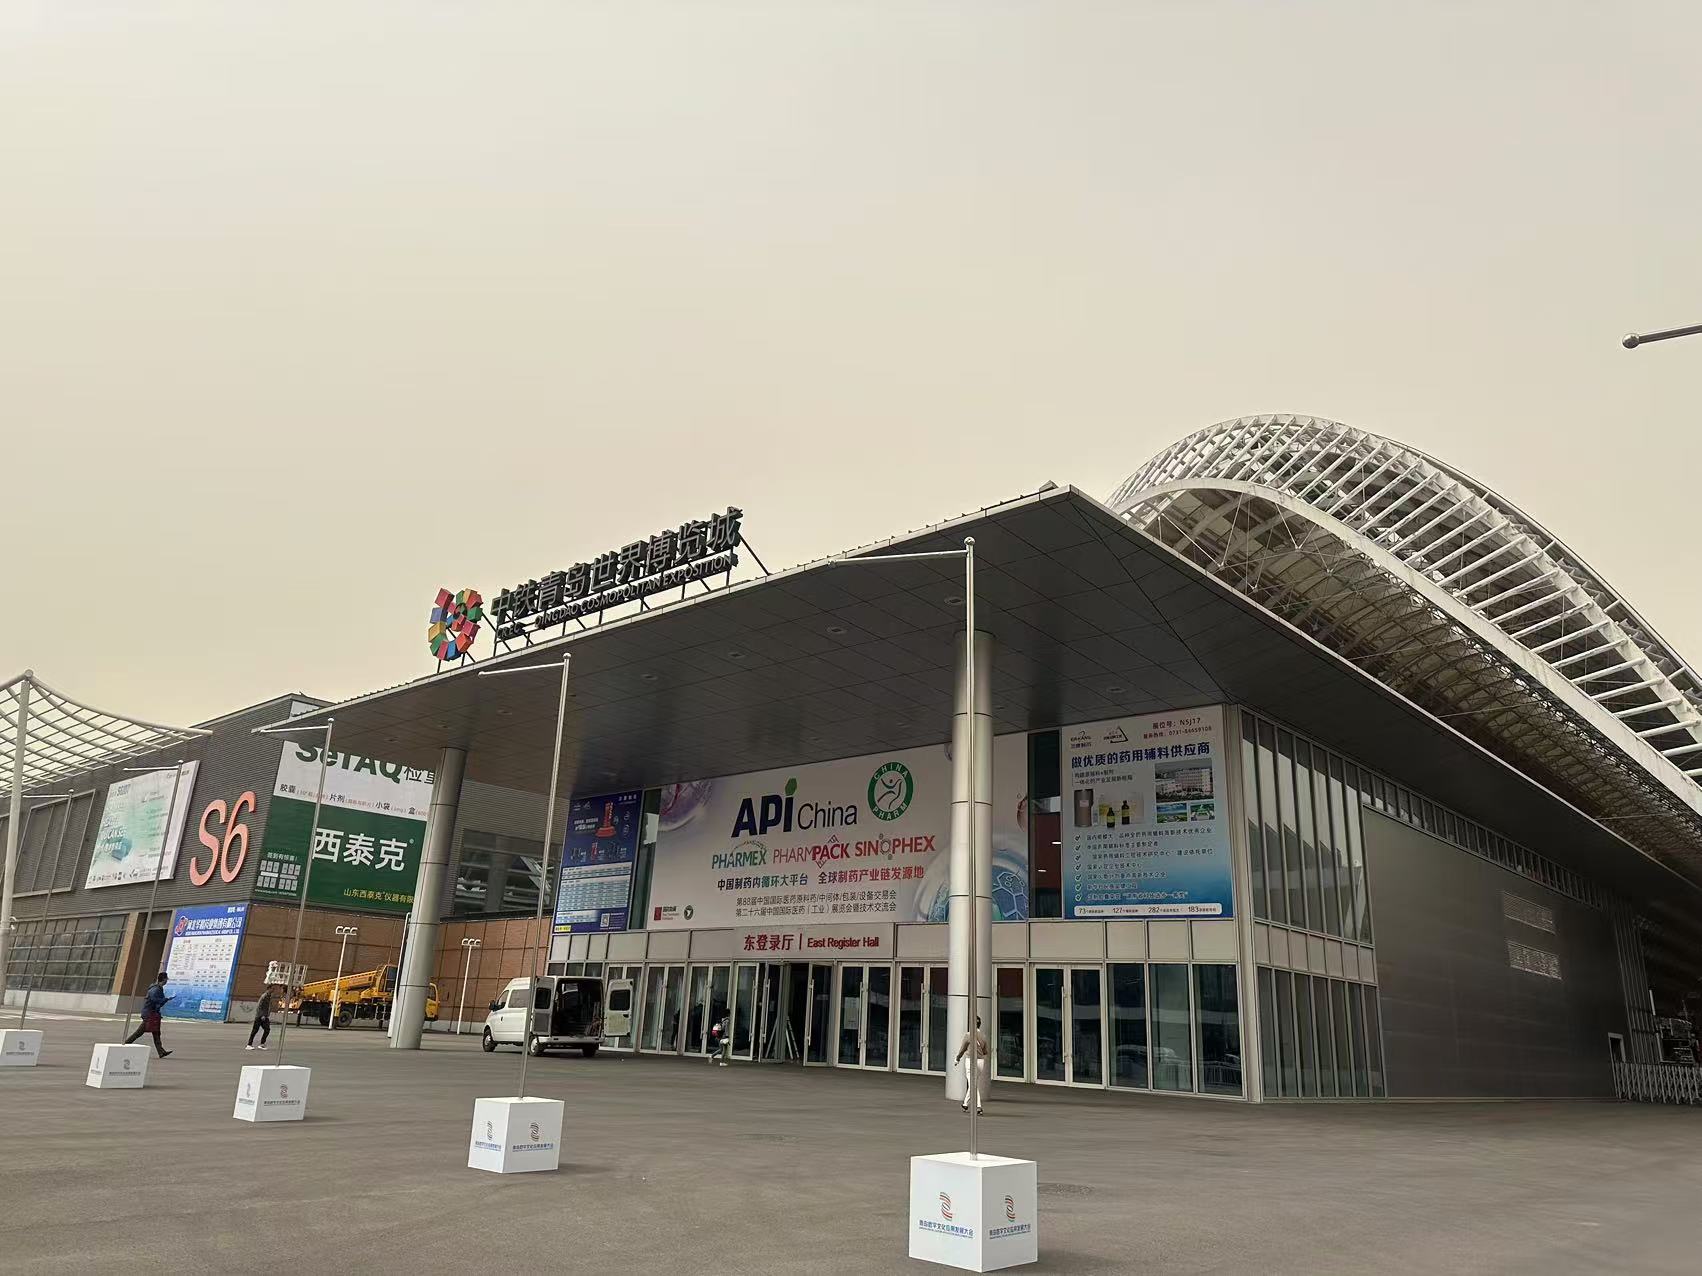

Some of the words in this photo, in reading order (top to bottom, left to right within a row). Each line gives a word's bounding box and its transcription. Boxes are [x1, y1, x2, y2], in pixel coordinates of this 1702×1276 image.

[490, 506, 743, 621] 中铁青岛世界博览城
[534, 603, 580, 630] QINGDAO
[580, 577, 662, 613] COSMOPOLITAN
[661, 553, 738, 589] EXPOSITION
[1071, 741, 1210, 769] 做优质的药用辅料供应商
[797, 800, 858, 830] China
[188, 790, 257, 888] S6
[312, 828, 408, 871] 西泰克
[712, 848, 767, 870] PHARMEX
[855, 835, 936, 858] SINOPHEX
[717, 872, 808, 891] 中国制药内循环大平台
[818, 866, 924, 883] 全球制药产业链发源地
[743, 934, 795, 951] 东登录厅
[807, 937, 826, 949] East
[827, 937, 861, 950] Register
[862, 936, 880, 948] Hall
